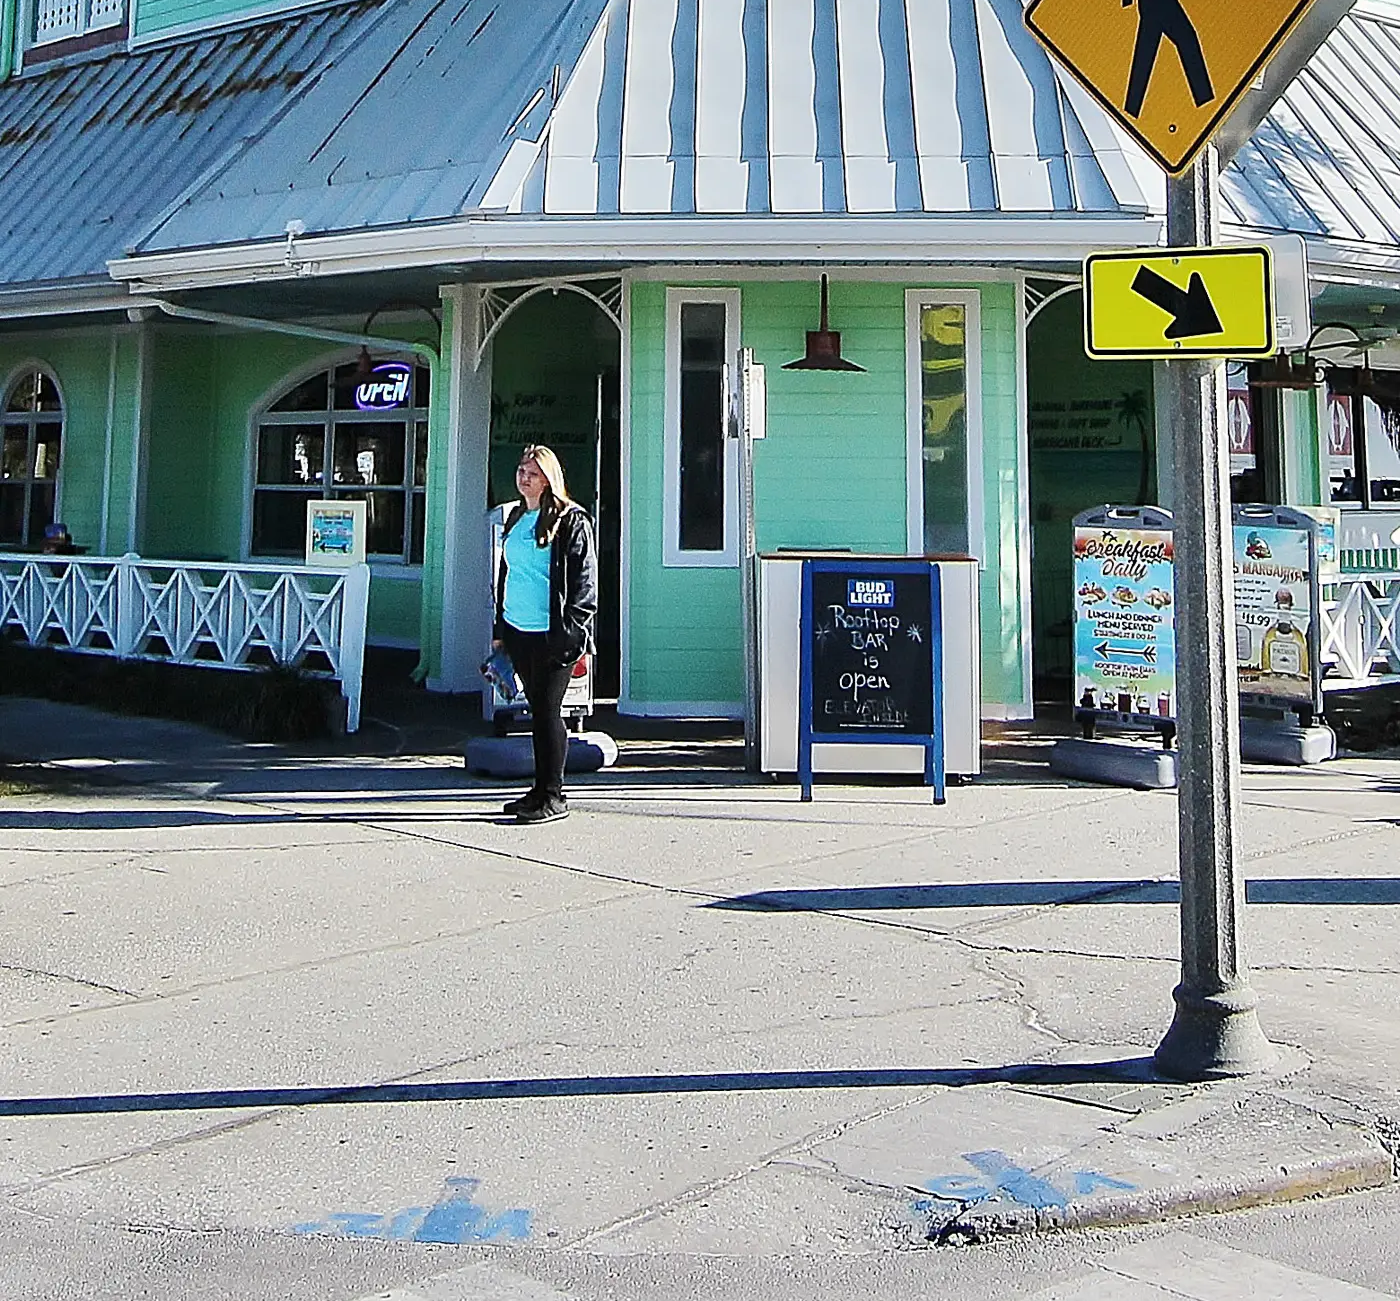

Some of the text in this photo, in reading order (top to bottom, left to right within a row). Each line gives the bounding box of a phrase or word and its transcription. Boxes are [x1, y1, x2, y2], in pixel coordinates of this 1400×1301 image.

[359, 373, 410, 402] OPEN
[1086, 539, 1165, 562] Breakfast
[1102, 559, 1147, 582] Daily
[856, 581, 886, 593] BUD
[850, 592, 892, 605] LIGHT
[827, 604, 900, 637] Rooftop
[1088, 609, 1163, 624] LUNCH AND DINNER
[1097, 620, 1154, 632] MENU SERVED
[851, 630, 889, 652] BAR
[862, 651, 879, 669] is
